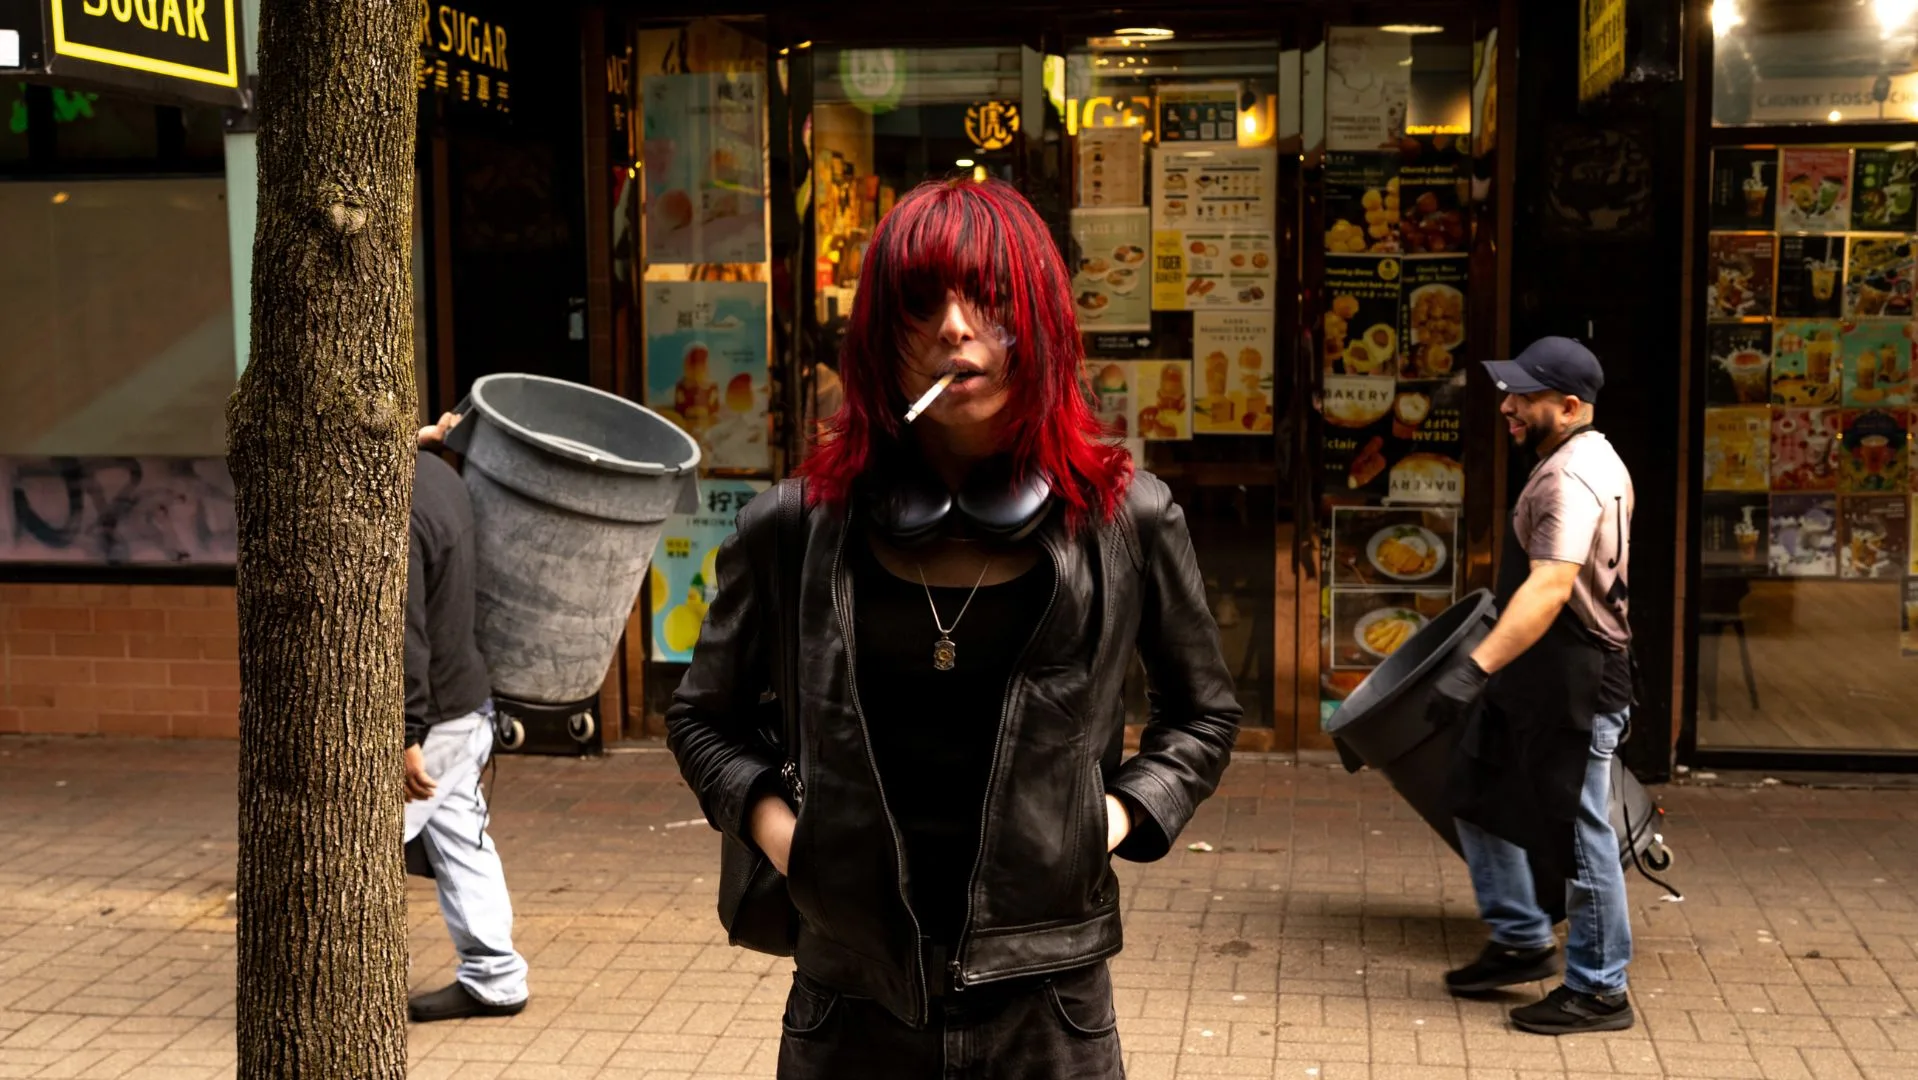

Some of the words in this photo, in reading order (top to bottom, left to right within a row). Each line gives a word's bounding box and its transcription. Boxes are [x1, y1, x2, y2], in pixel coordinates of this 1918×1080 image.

[84, 0, 210, 42] GAR
[438, 5, 509, 72] SUGAR
[1156, 255, 1182, 270] TIGER
[1324, 390, 1389, 401] BAKERY
[1412, 431, 1459, 442] CREAM
[1391, 479, 1456, 492] BAKERY
